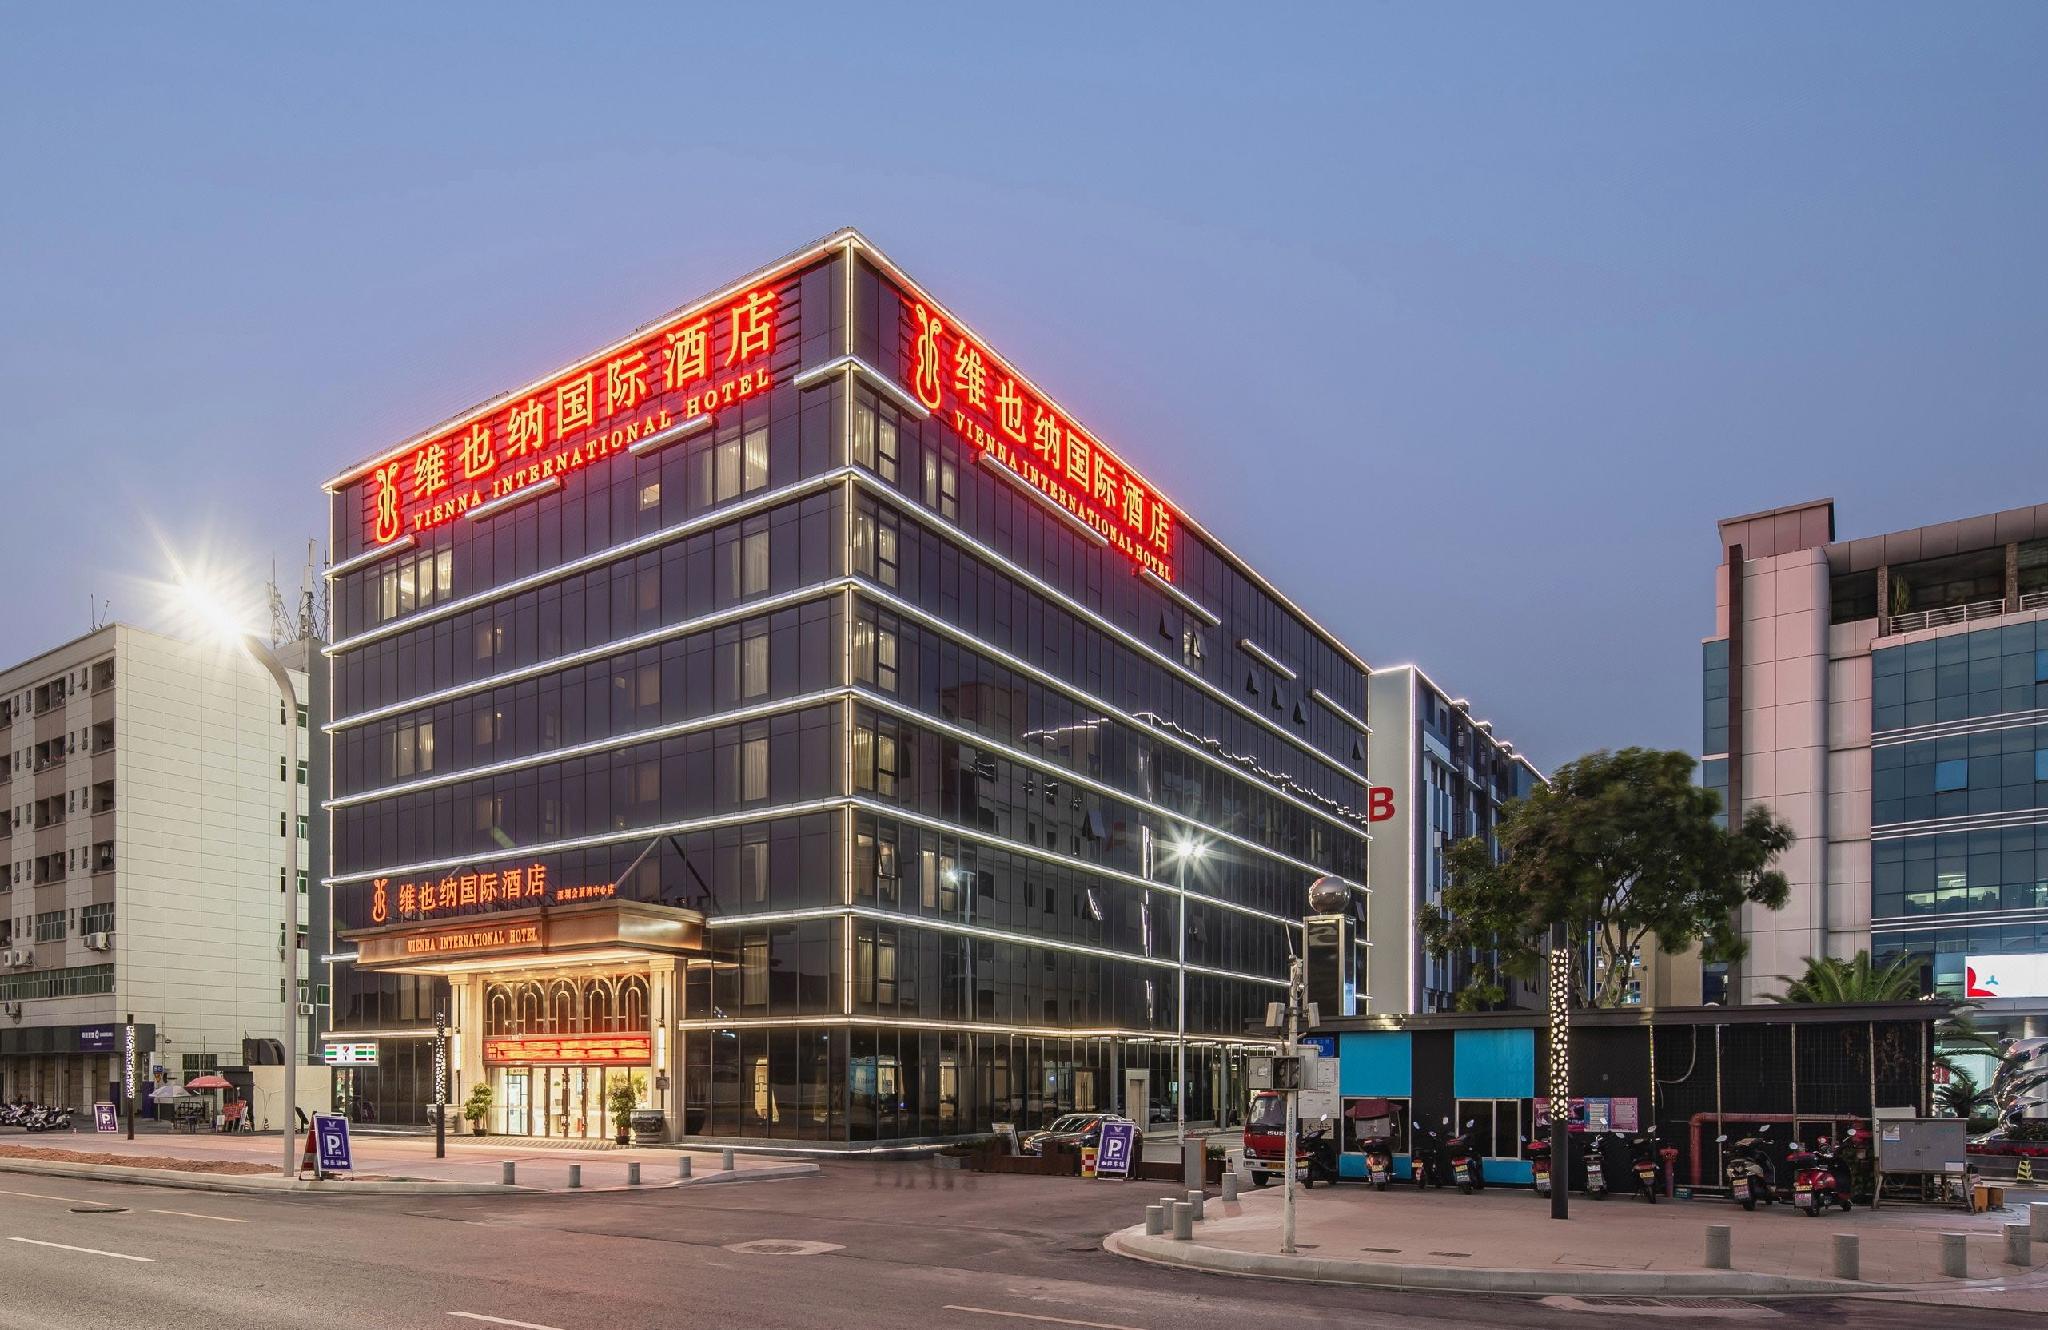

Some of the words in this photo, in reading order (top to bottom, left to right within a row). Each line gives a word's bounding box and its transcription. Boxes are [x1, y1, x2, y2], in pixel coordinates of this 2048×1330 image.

[412, 290, 778, 499] 维也纳国际酒店
[413, 487, 482, 530] VIENNA
[492, 408, 672, 500] INTERNATIONAL
[686, 366, 771, 417] HOTEL
[954, 339, 1171, 555] 维也纳国际酒店
[954, 410, 1018, 472] VIENNA
[1022, 461, 1134, 557] INTERNATIONAL
[1136, 546, 1172, 583] HOTEL
[1369, 786, 1395, 822] B
[399, 863, 547, 912] 维也纳国际酒店
[407, 935, 436, 953] VIENNA
[439, 930, 505, 950] INTERNATIONAL
[509, 927, 538, 944] HOTEL
[326, 1135, 340, 1155] P
[1108, 1139, 1122, 1157] P
